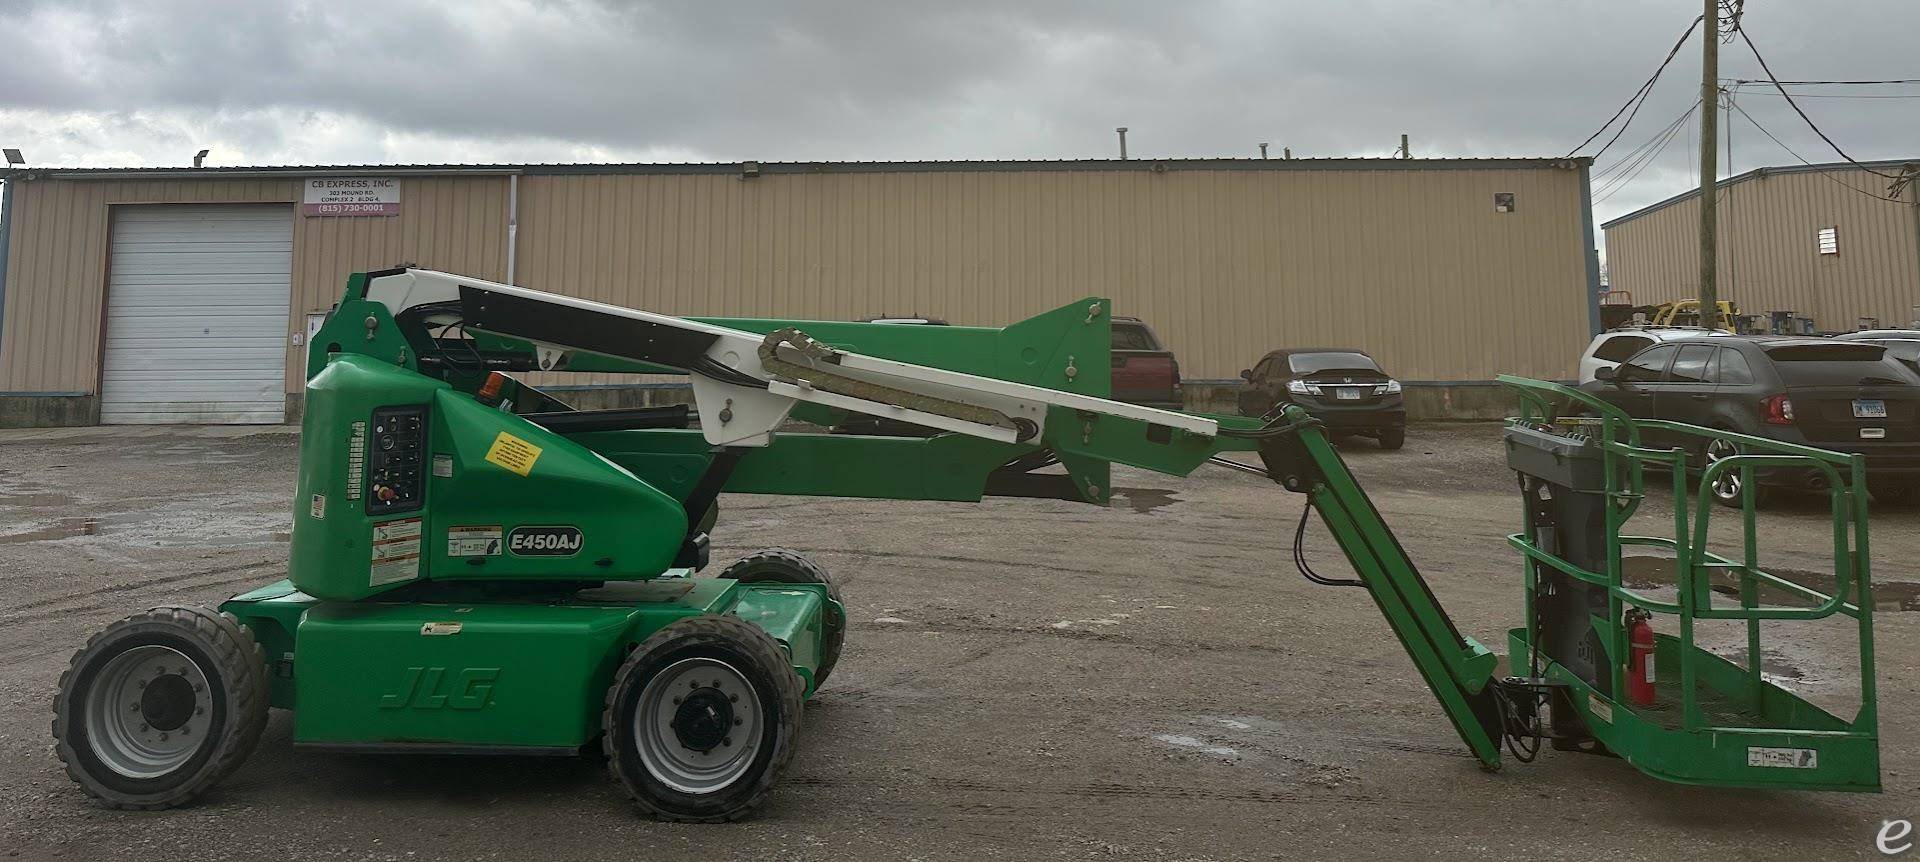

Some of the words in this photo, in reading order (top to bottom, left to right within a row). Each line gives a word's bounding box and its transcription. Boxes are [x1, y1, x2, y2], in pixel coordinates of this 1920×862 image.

[312, 180, 324, 188] CB
[327, 180, 371, 189] EXPRESS,
[373, 180, 394, 188] INC.
[318, 204, 342, 213] (815)
[344, 204, 384, 212] 730-0001
[510, 534, 581, 550] E450AJ
[379, 666, 502, 710] JLG
